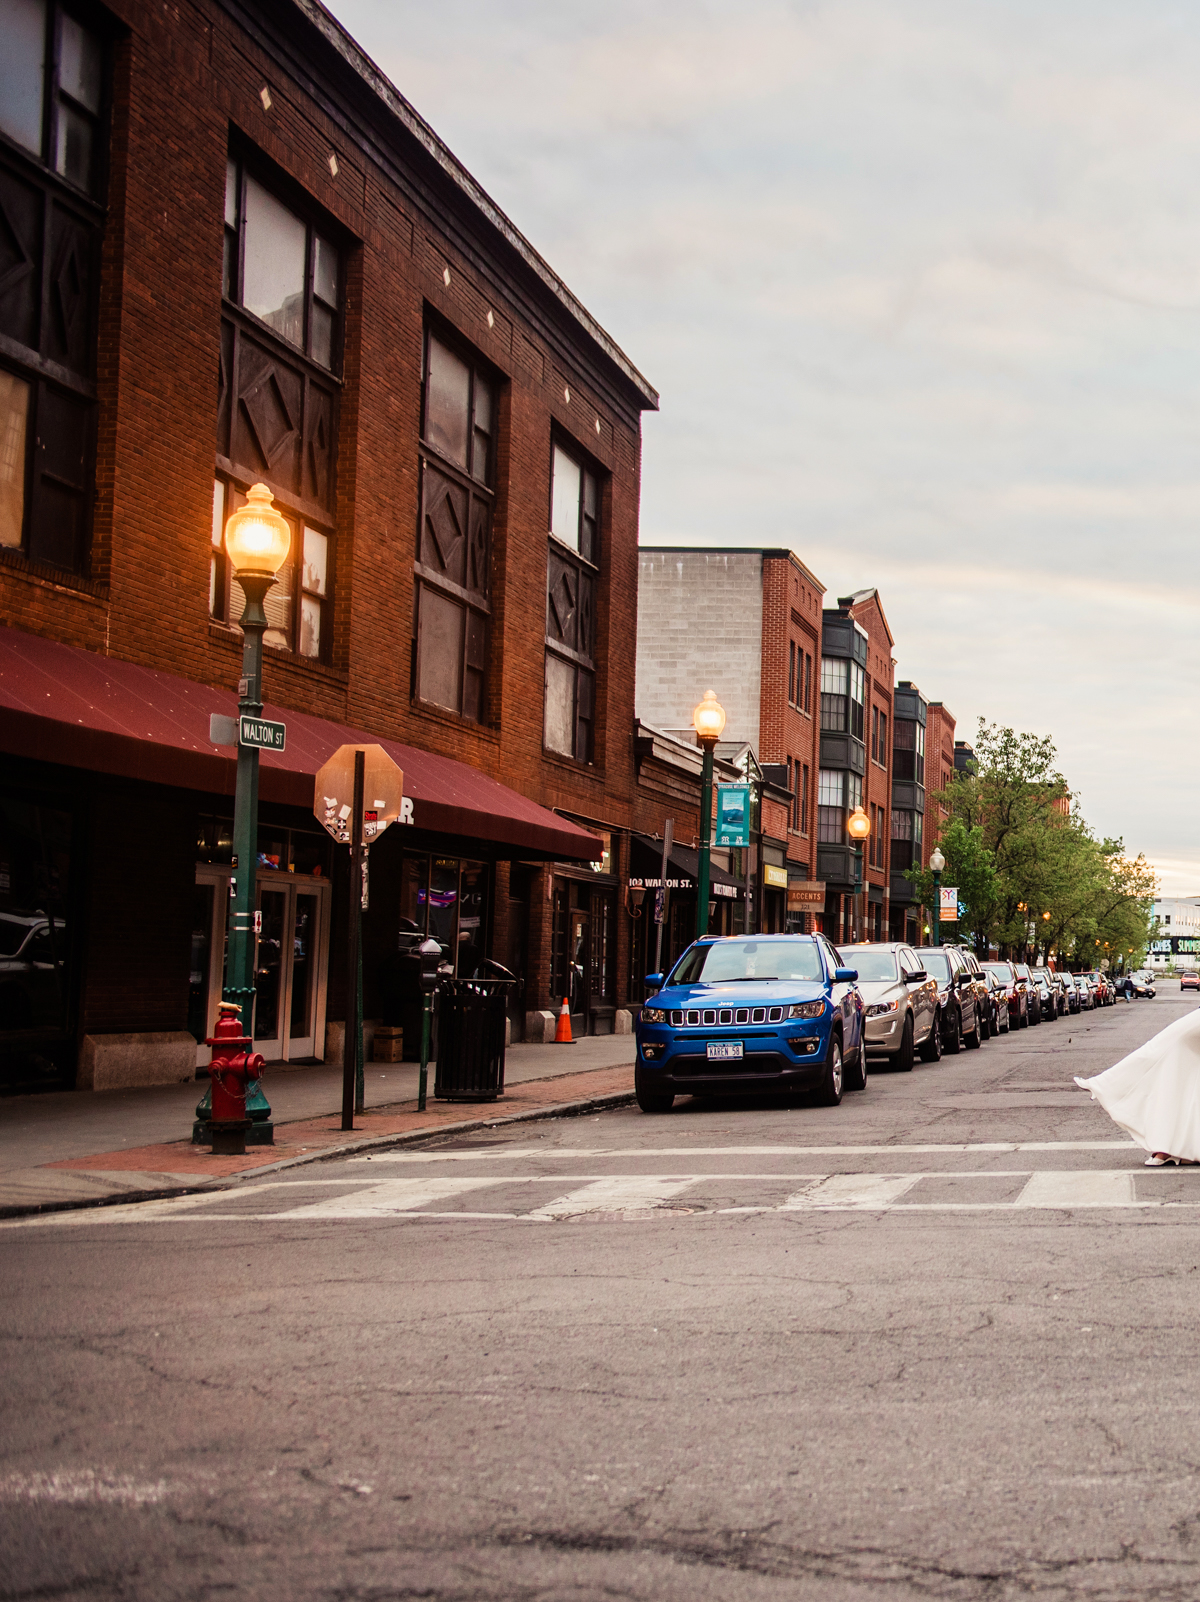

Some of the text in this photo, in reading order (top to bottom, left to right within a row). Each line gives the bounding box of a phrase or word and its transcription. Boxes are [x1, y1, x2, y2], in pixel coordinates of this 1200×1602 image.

[243, 722, 283, 745] WALTON ST
[644, 878, 679, 888] WALON
[680, 879, 693, 888] ST.
[792, 892, 821, 900] ACCENTS
[1177, 939, 1200, 952] SUMME
